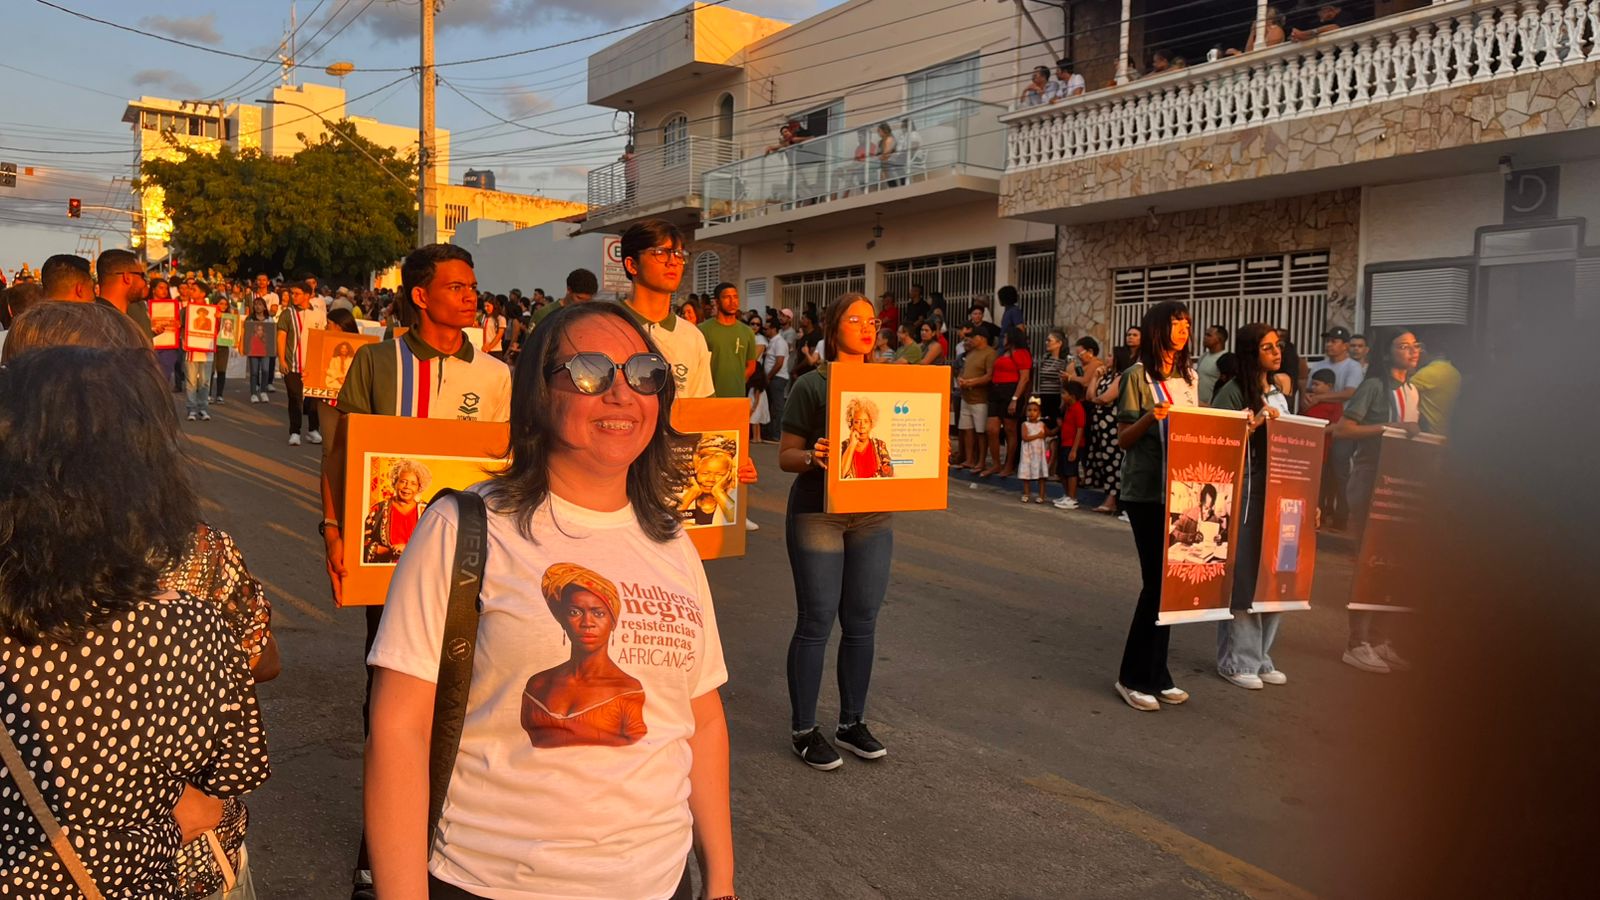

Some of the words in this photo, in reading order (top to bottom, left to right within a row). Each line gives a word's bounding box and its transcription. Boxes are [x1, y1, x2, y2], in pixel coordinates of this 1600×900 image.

[1170, 432, 1198, 444] Carolina
[1199, 434, 1217, 445] Maria
[1217, 436, 1225, 445] de
[1225, 437, 1241, 447] Jesus
[622, 598, 704, 628] negras
[621, 619, 696, 638] resistências
[621, 632, 629, 643] e
[633, 630, 692, 651] heranças
[617, 647, 696, 672] AFRICANAS
